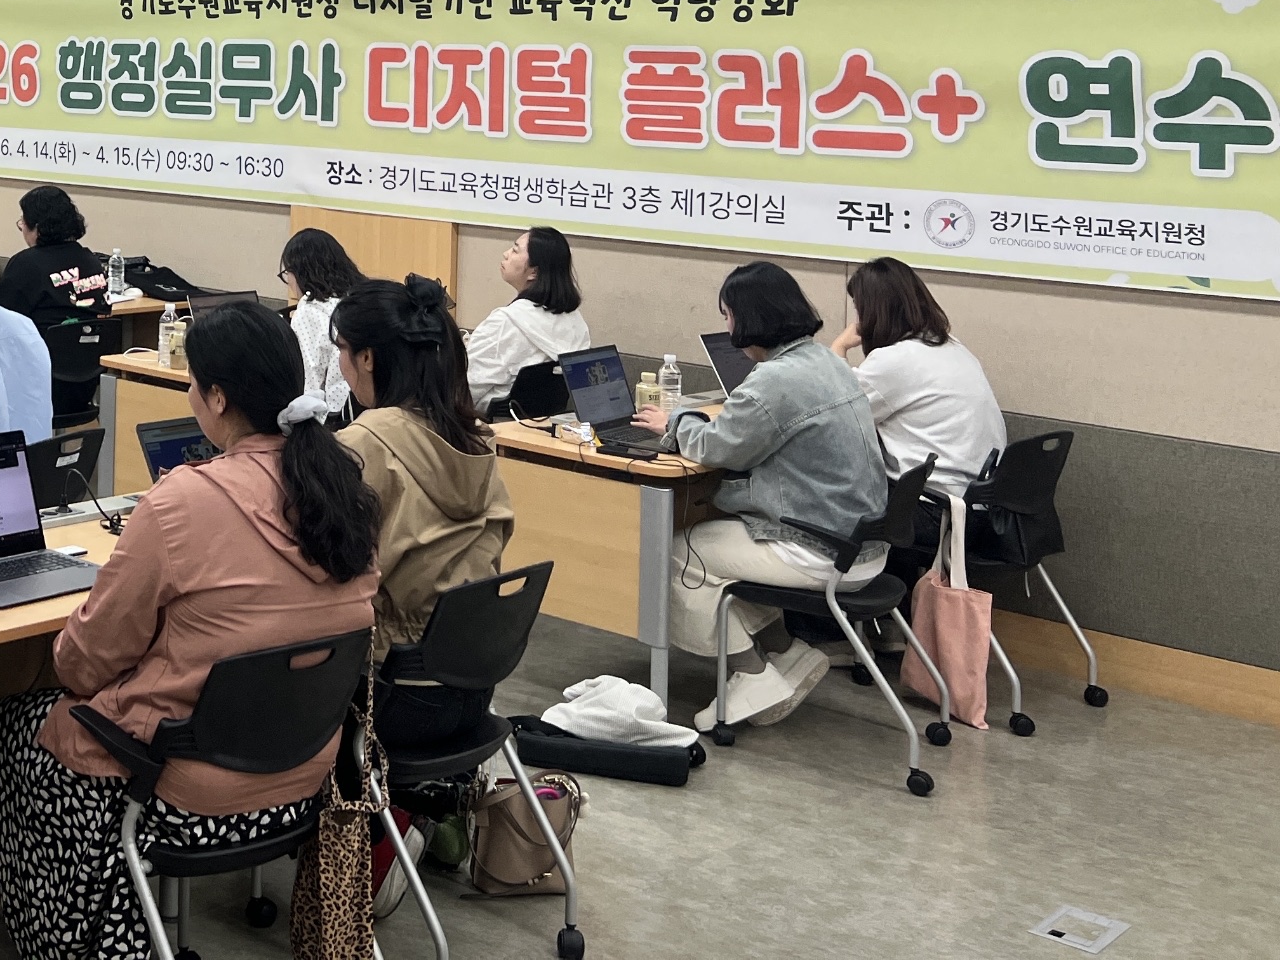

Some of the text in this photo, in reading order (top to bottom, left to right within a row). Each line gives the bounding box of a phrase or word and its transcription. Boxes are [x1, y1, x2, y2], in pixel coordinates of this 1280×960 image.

[58, 41, 343, 122] 행정실무사
[368, 45, 587, 136] 디지털
[1025, 55, 1274, 170] 연수
[33, 141, 77, 166] 14.(화)
[113, 146, 161, 173] 15.(수)
[166, 150, 214, 173] 09:30
[235, 155, 284, 178] 16:30
[379, 165, 614, 209] 경기도교육청평생학습관
[622, 185, 662, 214] 3층
[670, 188, 785, 225] 제1강의실
[989, 210, 1206, 246] 경기도수원교육지원청
[989, 236, 1206, 261] GYEONGGIDO SUWON OFFICE OF EDUCATION
